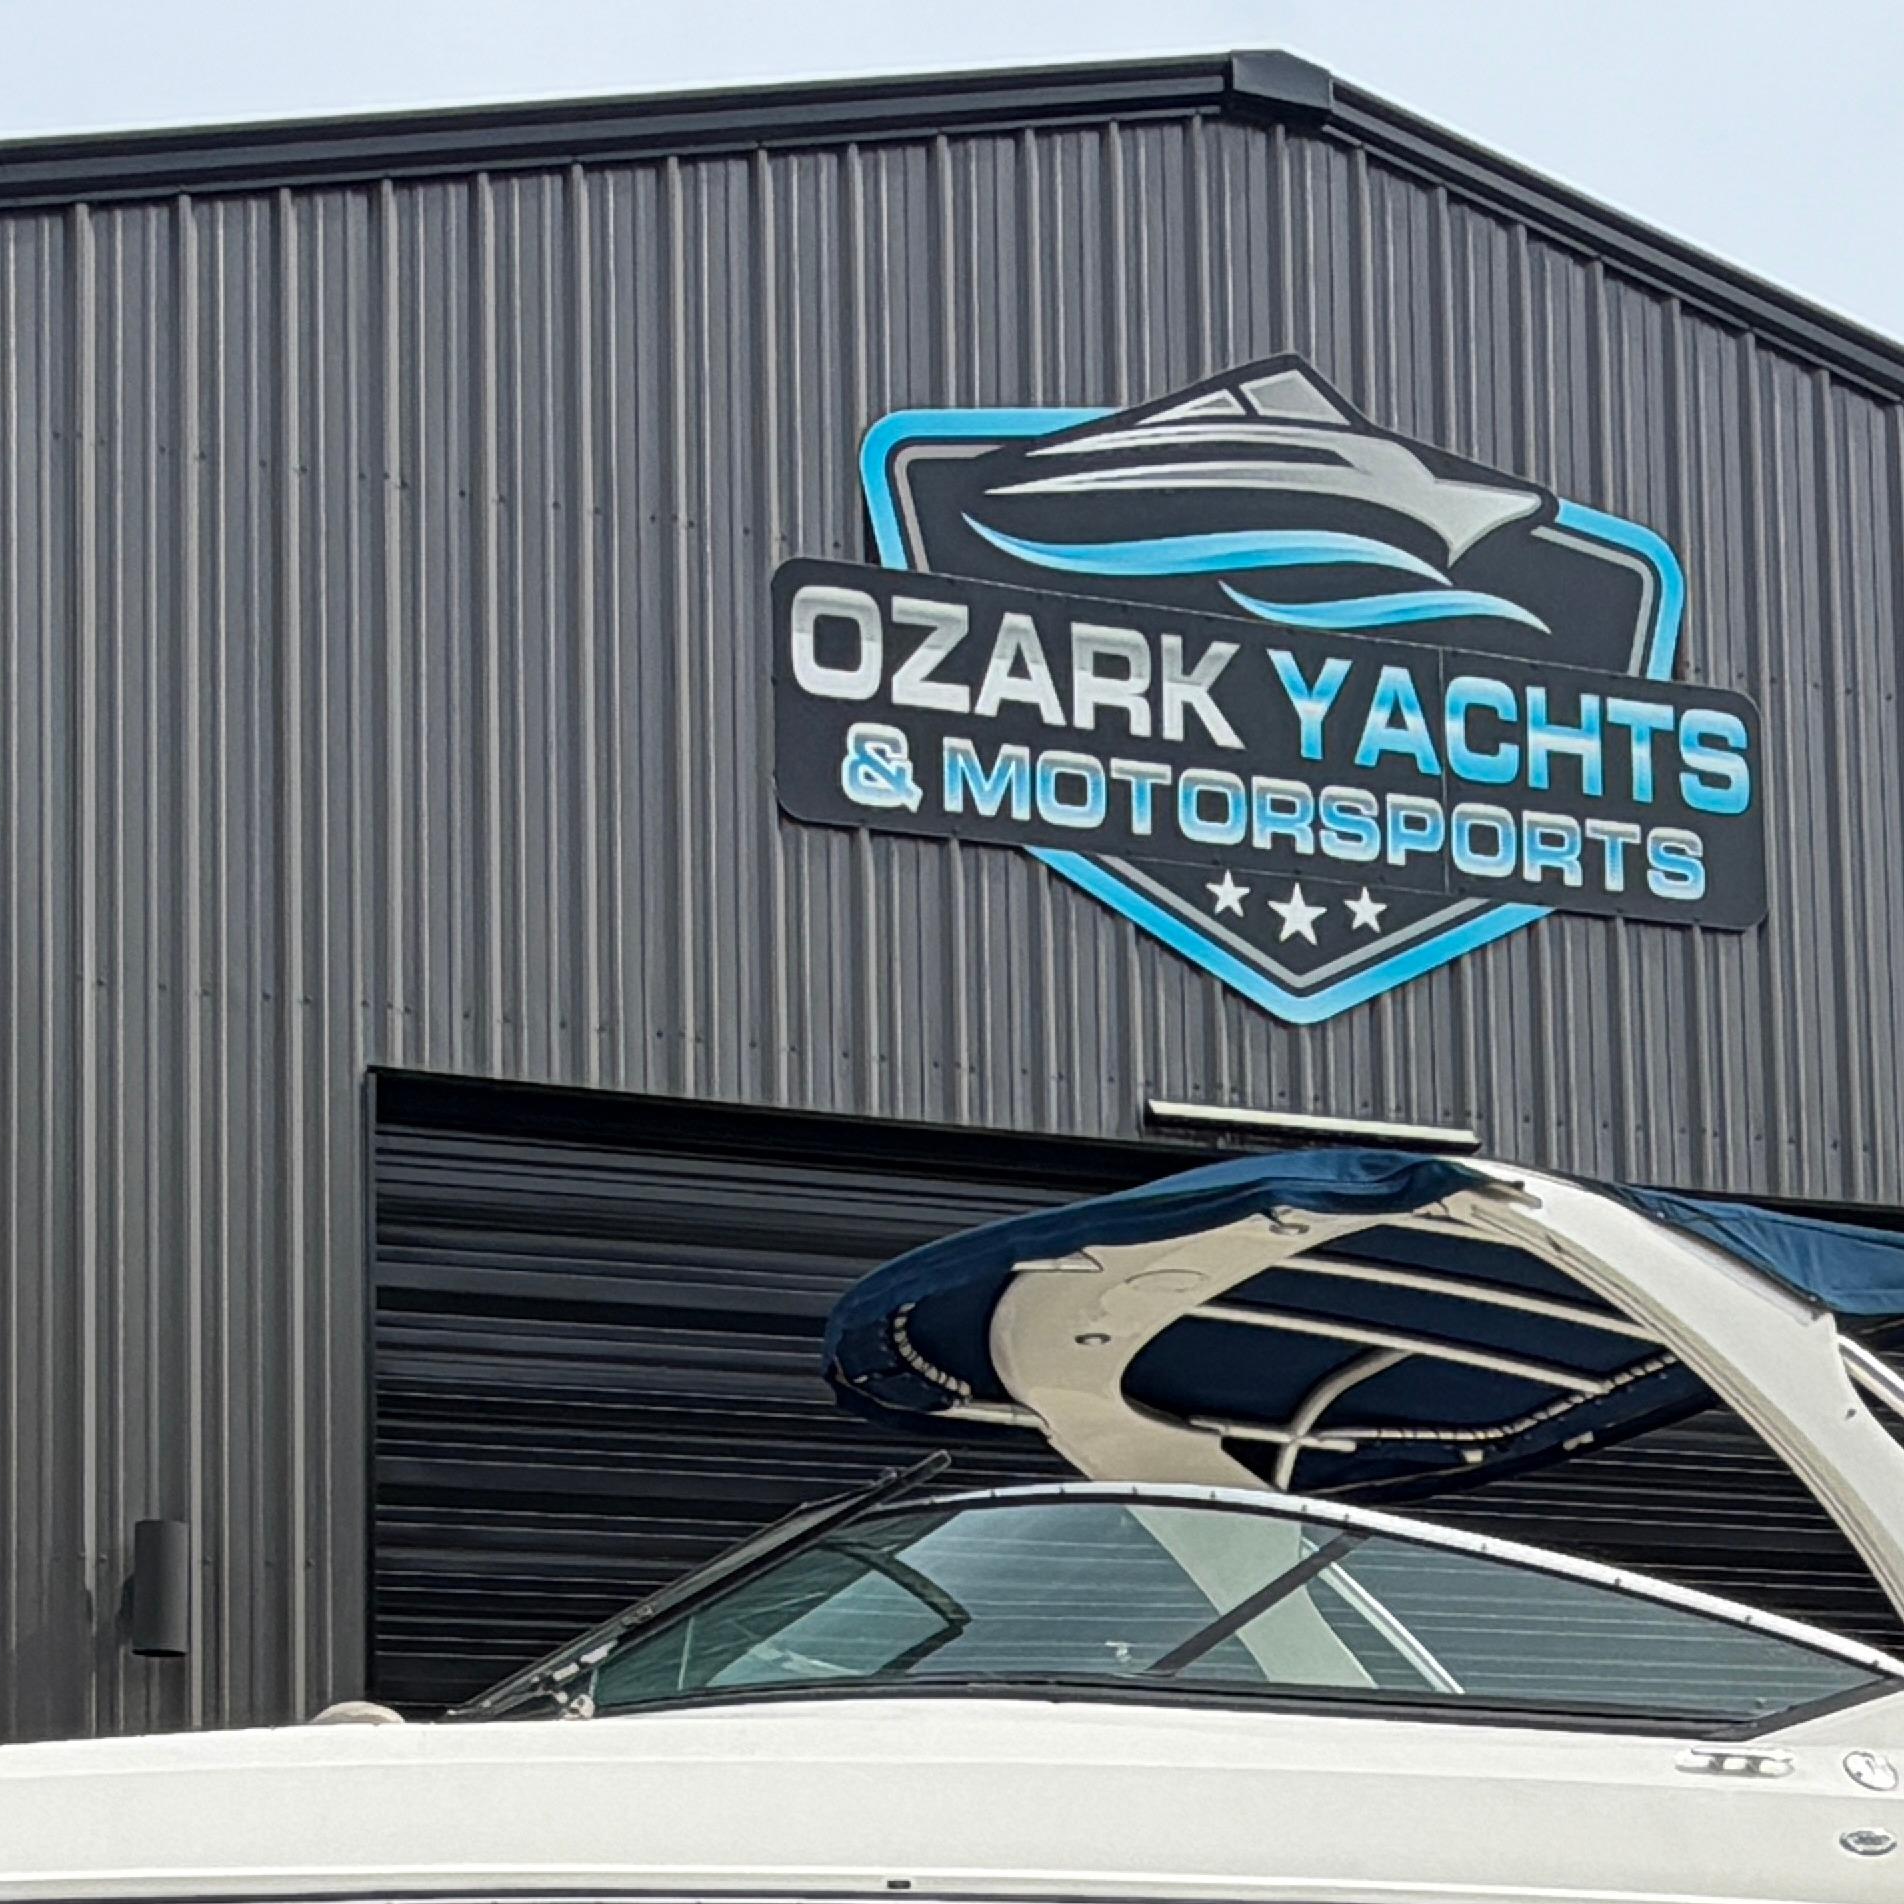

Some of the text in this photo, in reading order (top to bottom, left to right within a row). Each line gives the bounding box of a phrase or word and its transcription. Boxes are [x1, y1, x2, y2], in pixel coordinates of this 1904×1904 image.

[789, 584, 1752, 816] OZARK YACHTS
[842, 722, 1708, 902] & MOTORSPORTS
